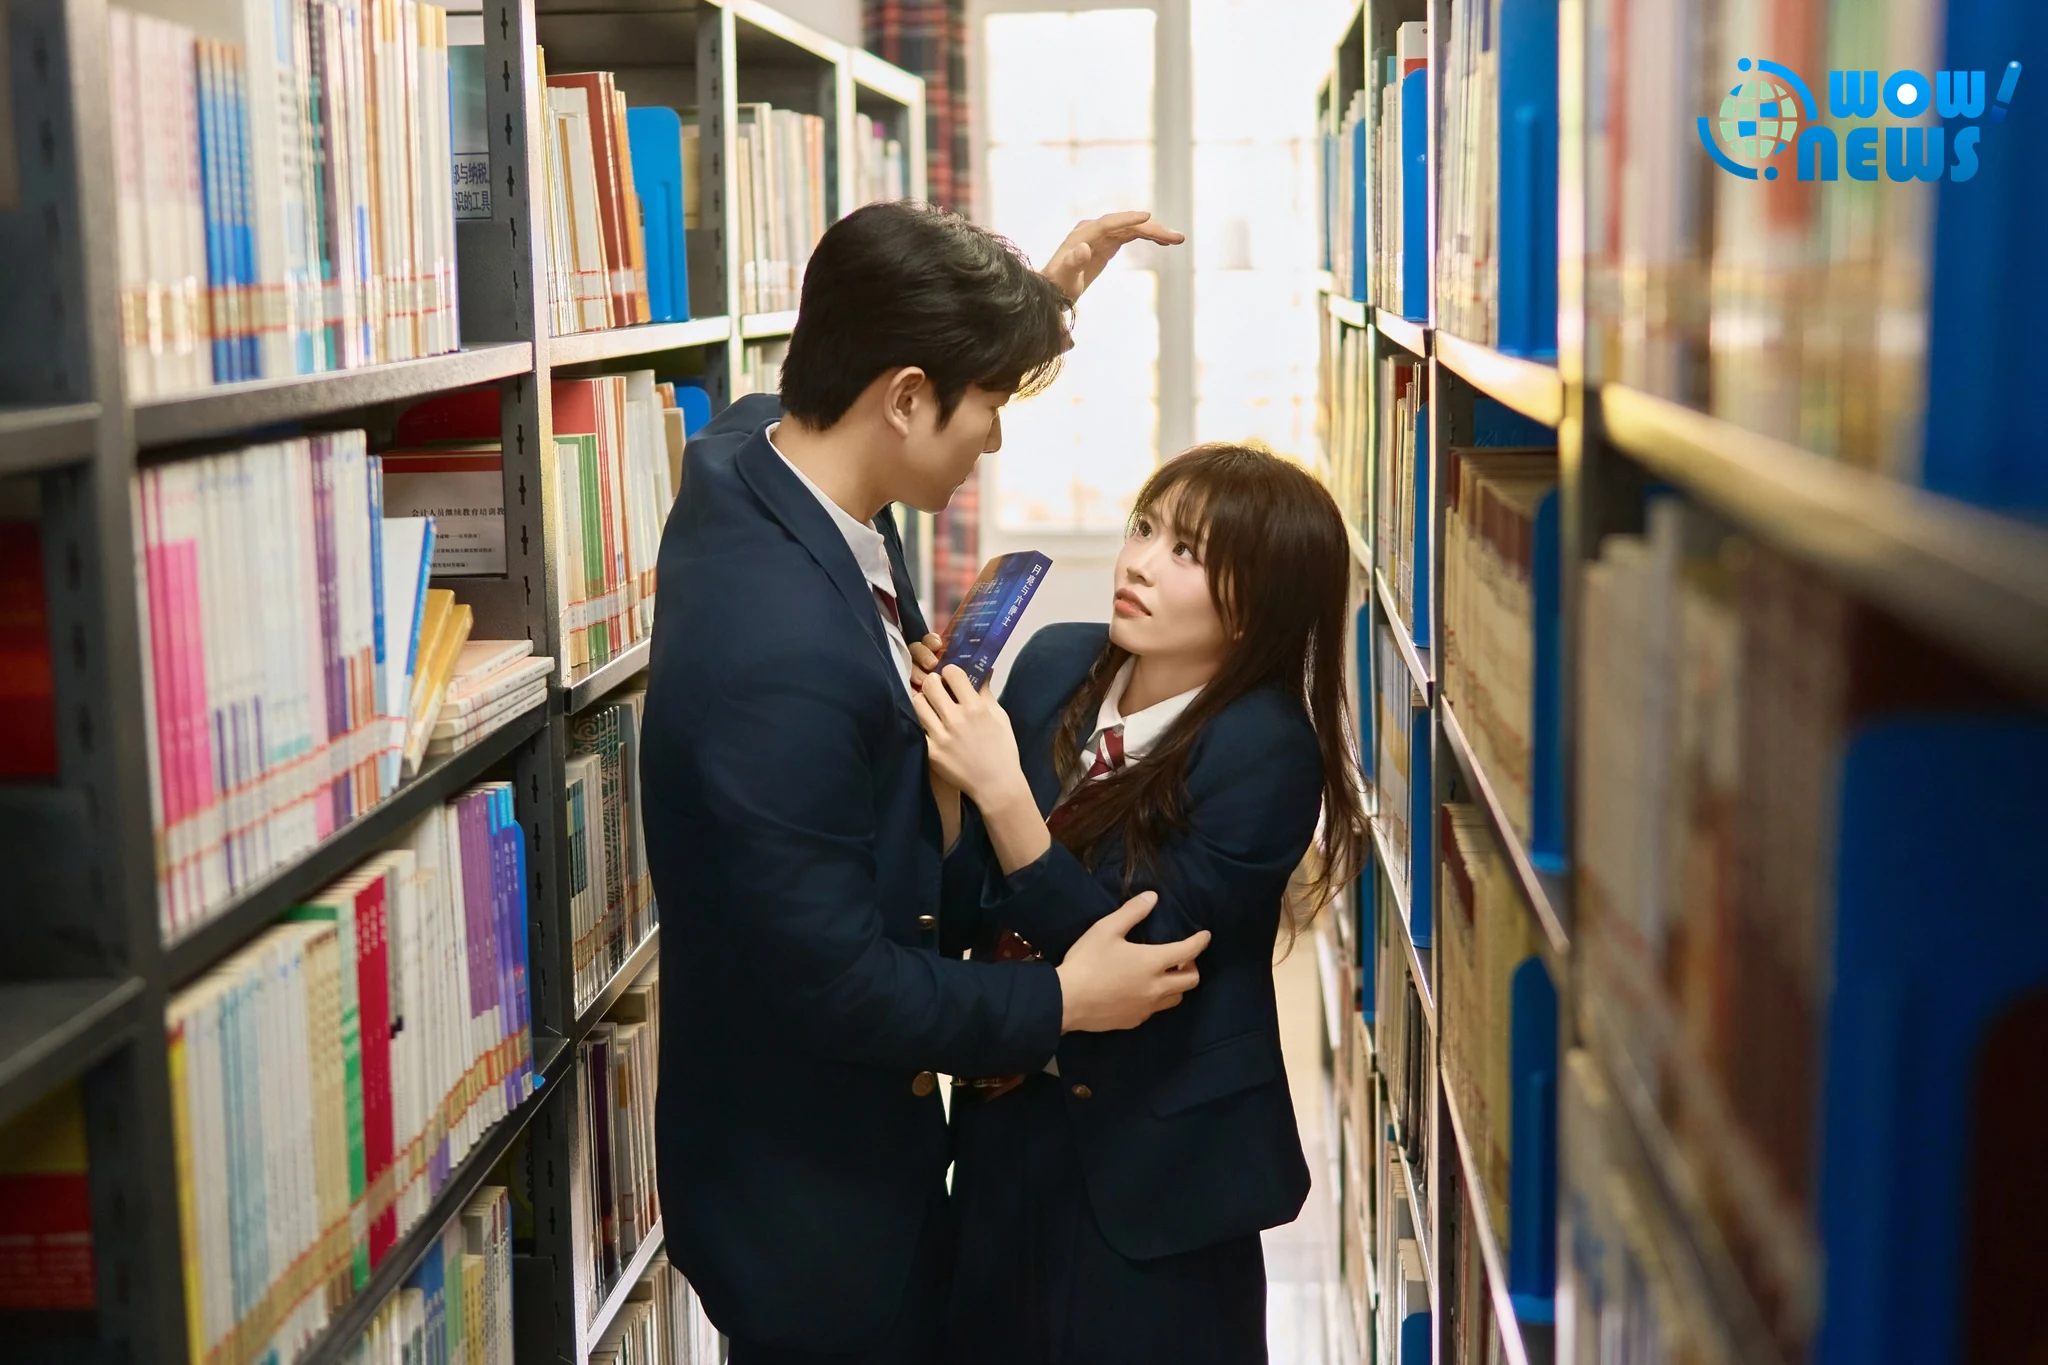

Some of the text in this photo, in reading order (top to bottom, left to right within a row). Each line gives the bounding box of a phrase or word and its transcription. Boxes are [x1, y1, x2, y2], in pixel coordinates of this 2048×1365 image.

[1001, 564, 1042, 627] 月亮与六便士
